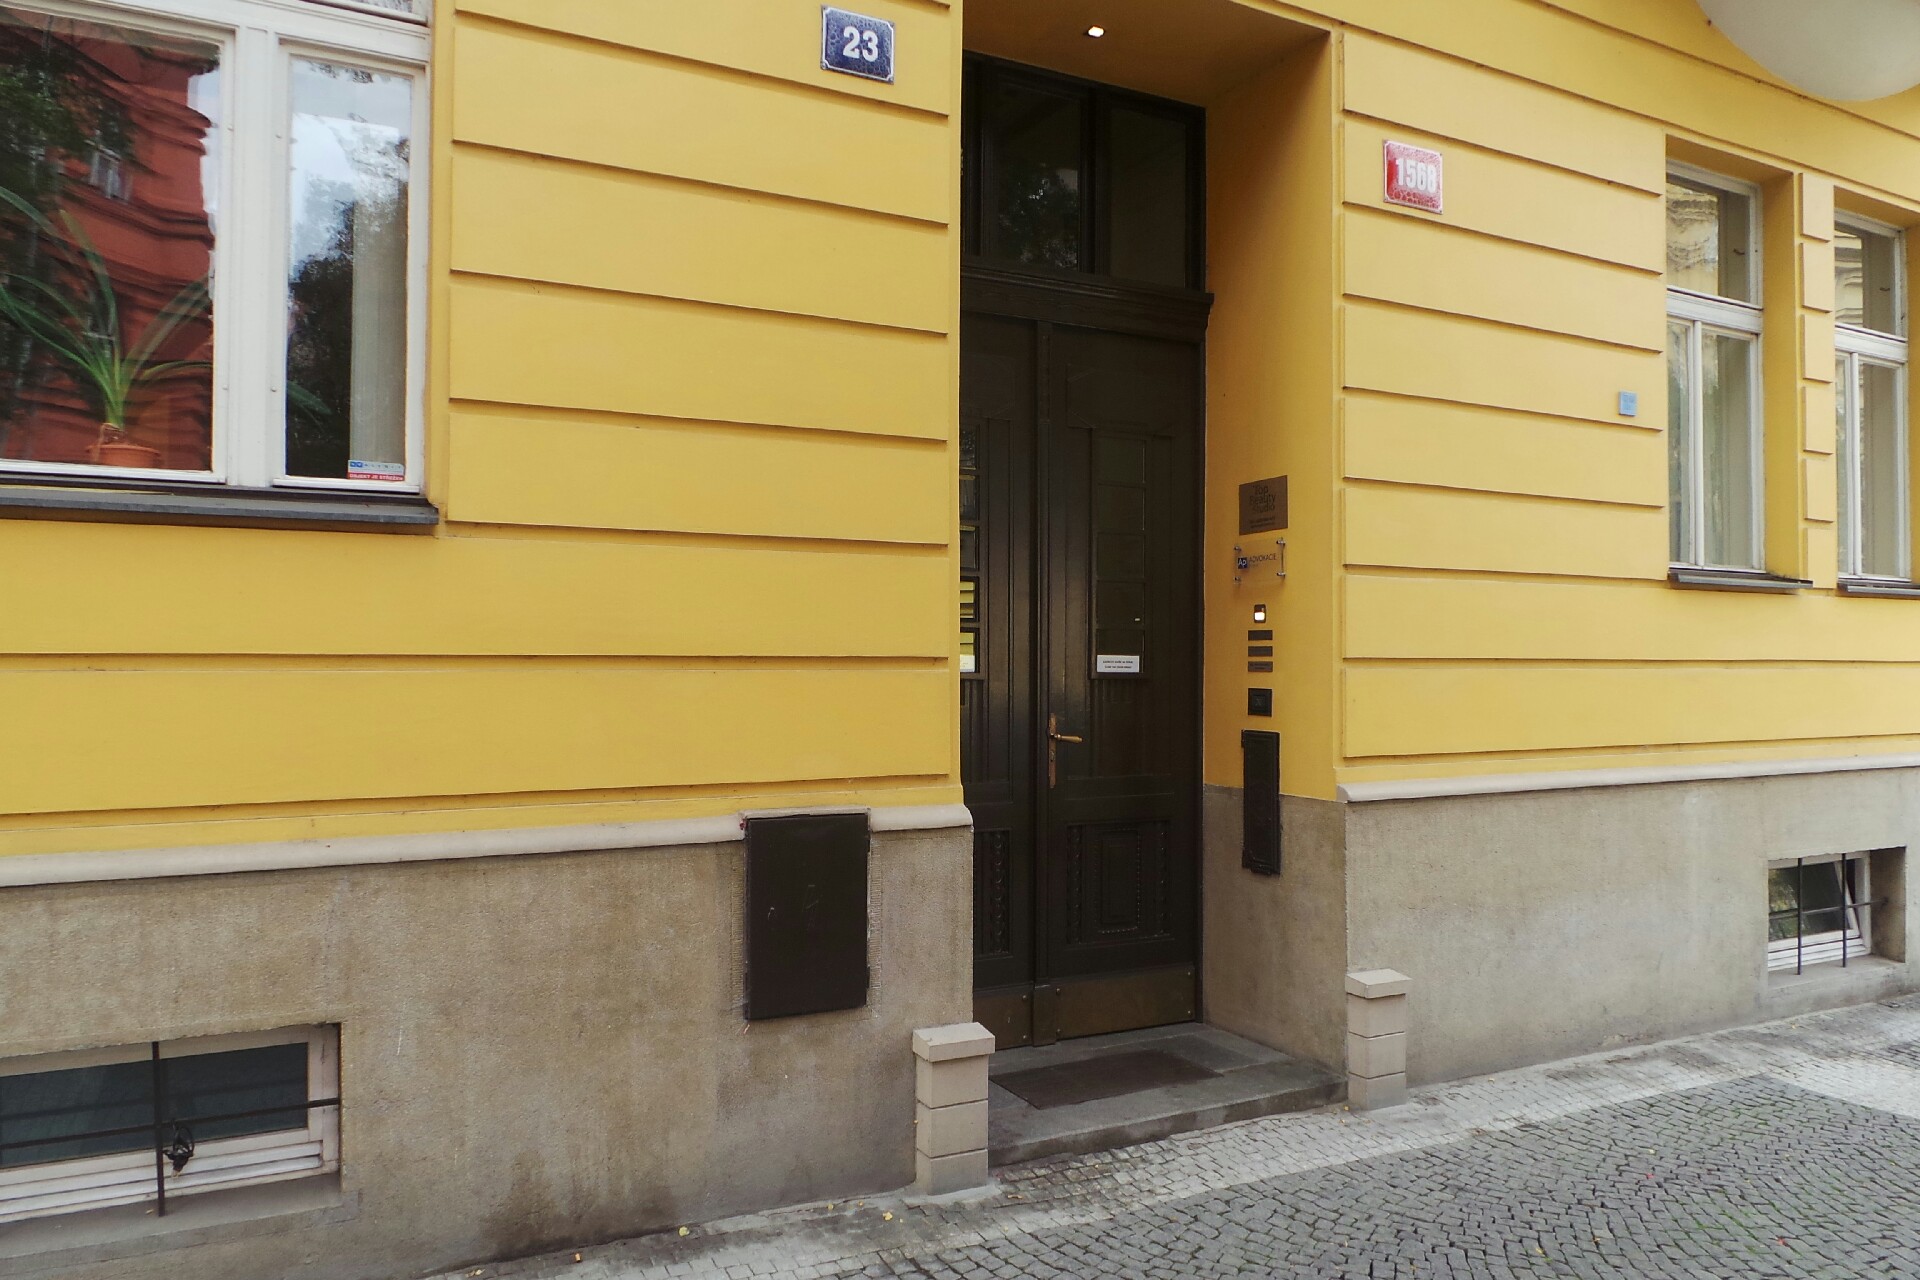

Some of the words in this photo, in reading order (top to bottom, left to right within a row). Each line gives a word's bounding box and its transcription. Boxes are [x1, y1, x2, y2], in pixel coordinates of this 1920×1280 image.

[843, 26, 878, 62] 23
[1396, 158, 1436, 193] 1568
[1249, 494, 1276, 505] Beauty
[1252, 485, 1269, 496] Top
